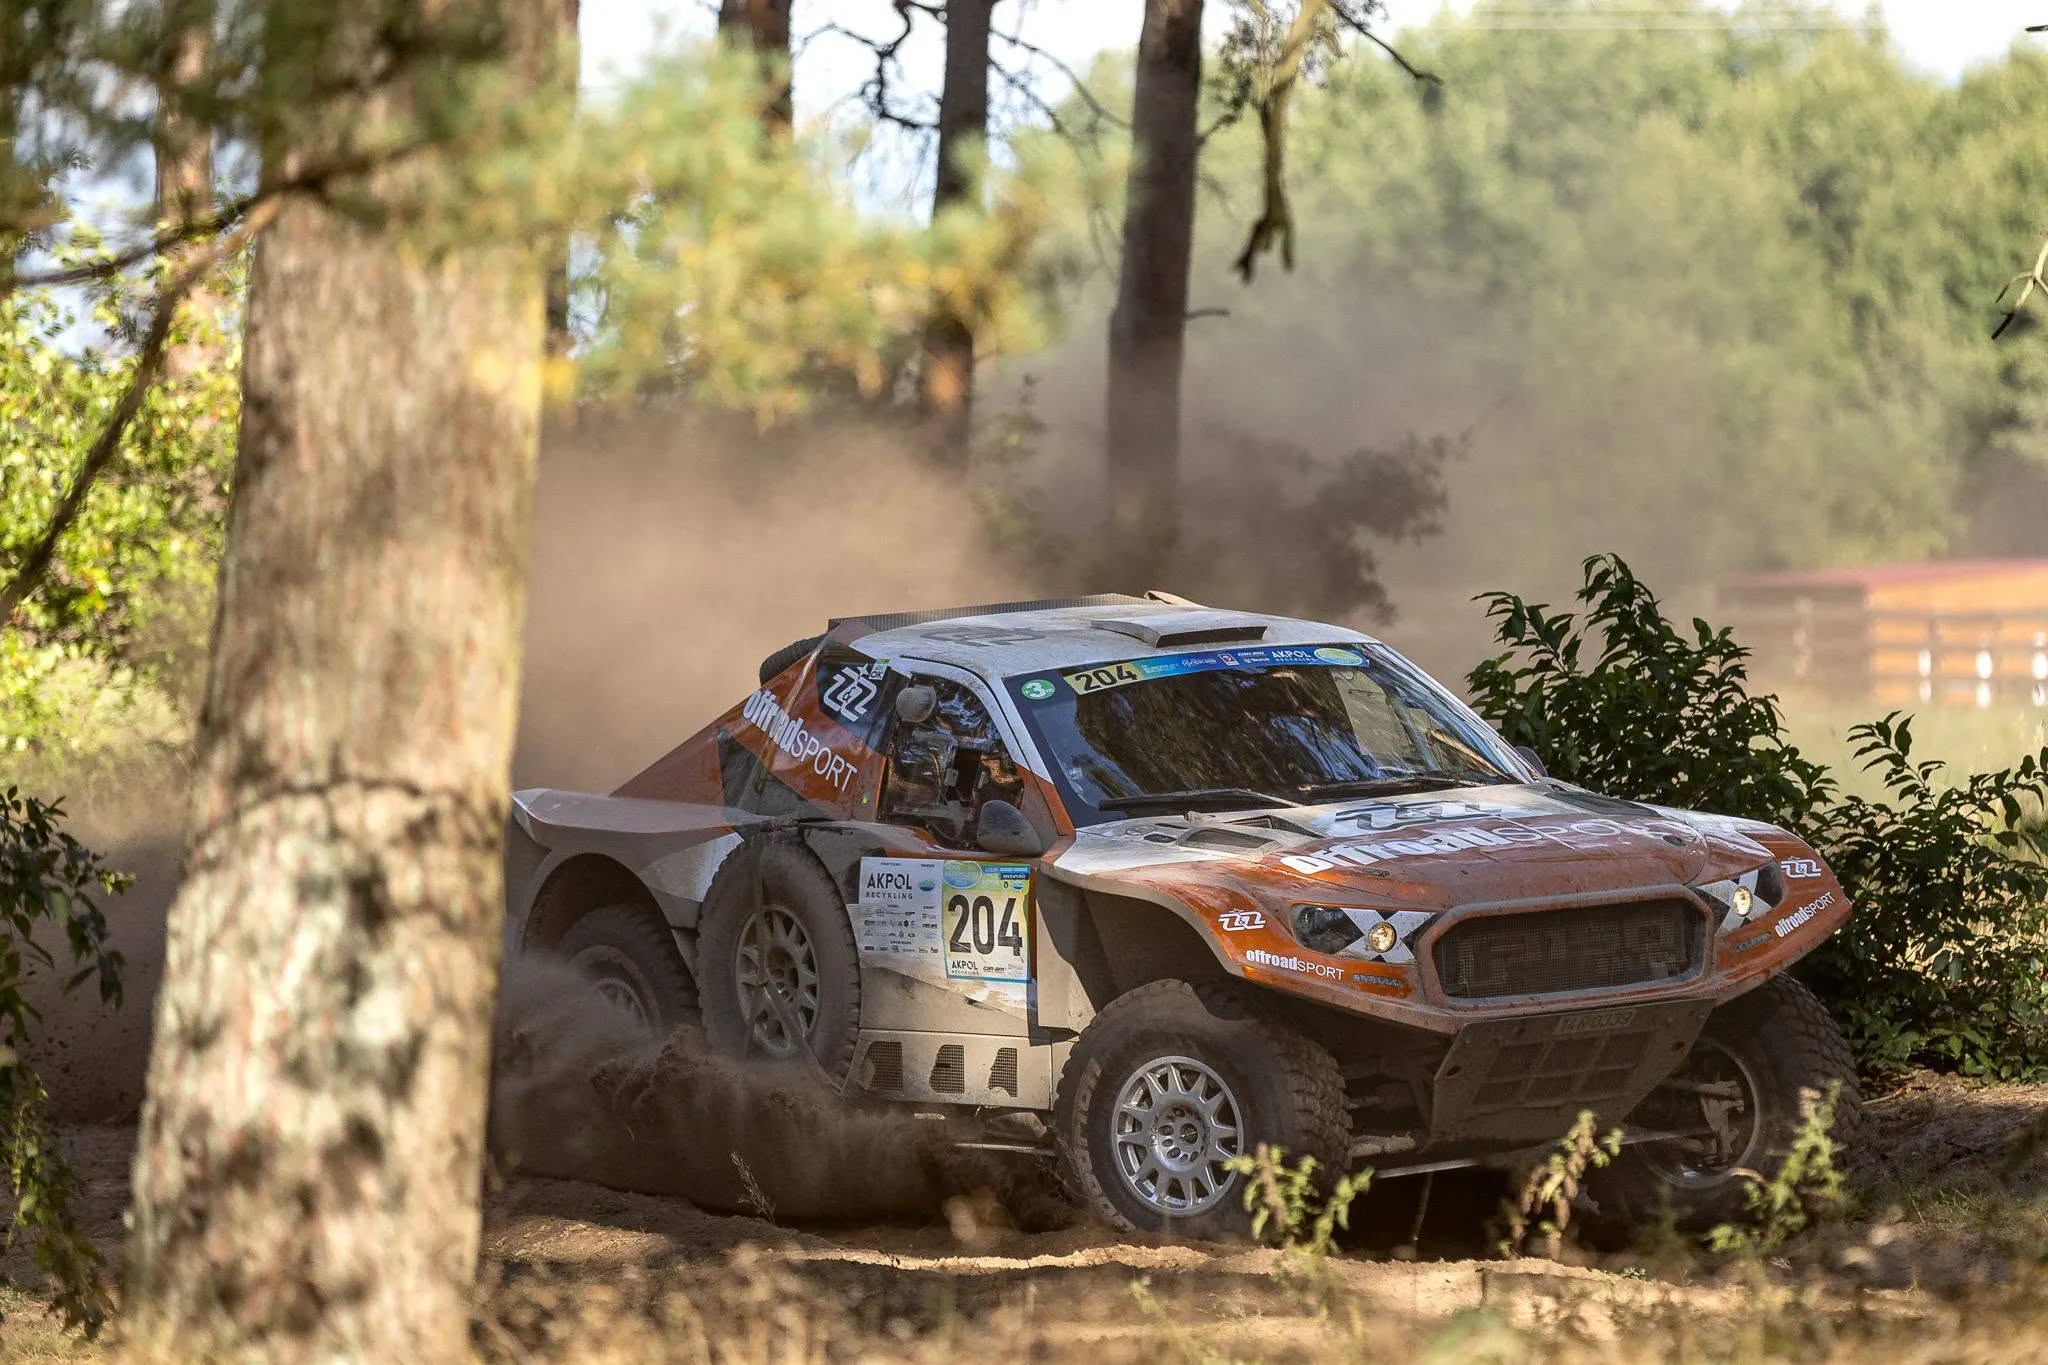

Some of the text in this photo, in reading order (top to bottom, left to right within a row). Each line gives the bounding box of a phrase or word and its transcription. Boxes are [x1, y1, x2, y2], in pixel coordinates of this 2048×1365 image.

[1271, 650, 1311, 659] AKPOL
[1075, 665, 1138, 692] 204
[866, 872, 913, 891] AKPOL
[865, 891, 914, 900] RECYKLING
[948, 894, 1023, 957] 204
[1774, 891, 1836, 938] offroadSPORT
[951, 960, 979, 971] AKPOL
[1246, 949, 1345, 981] offroadSPORT
